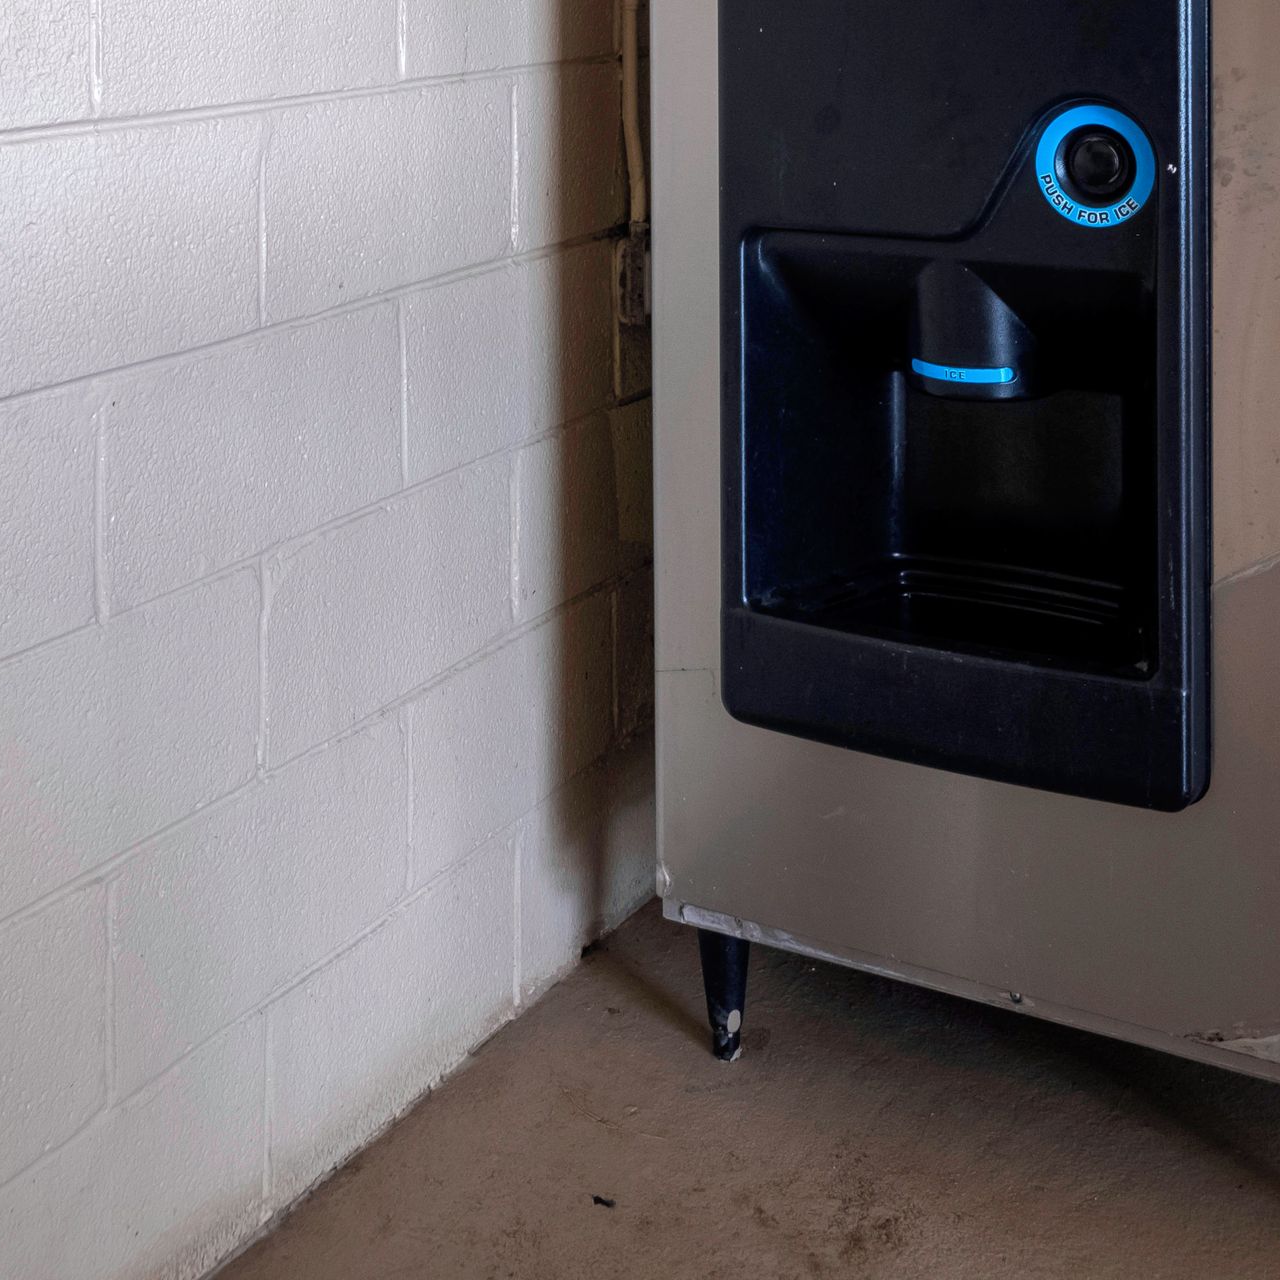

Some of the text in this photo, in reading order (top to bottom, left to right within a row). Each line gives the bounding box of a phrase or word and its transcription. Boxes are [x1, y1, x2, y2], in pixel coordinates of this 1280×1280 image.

[1041, 174, 1139, 224] PUSH FOR ICE
[945, 368, 966, 380] ICE
